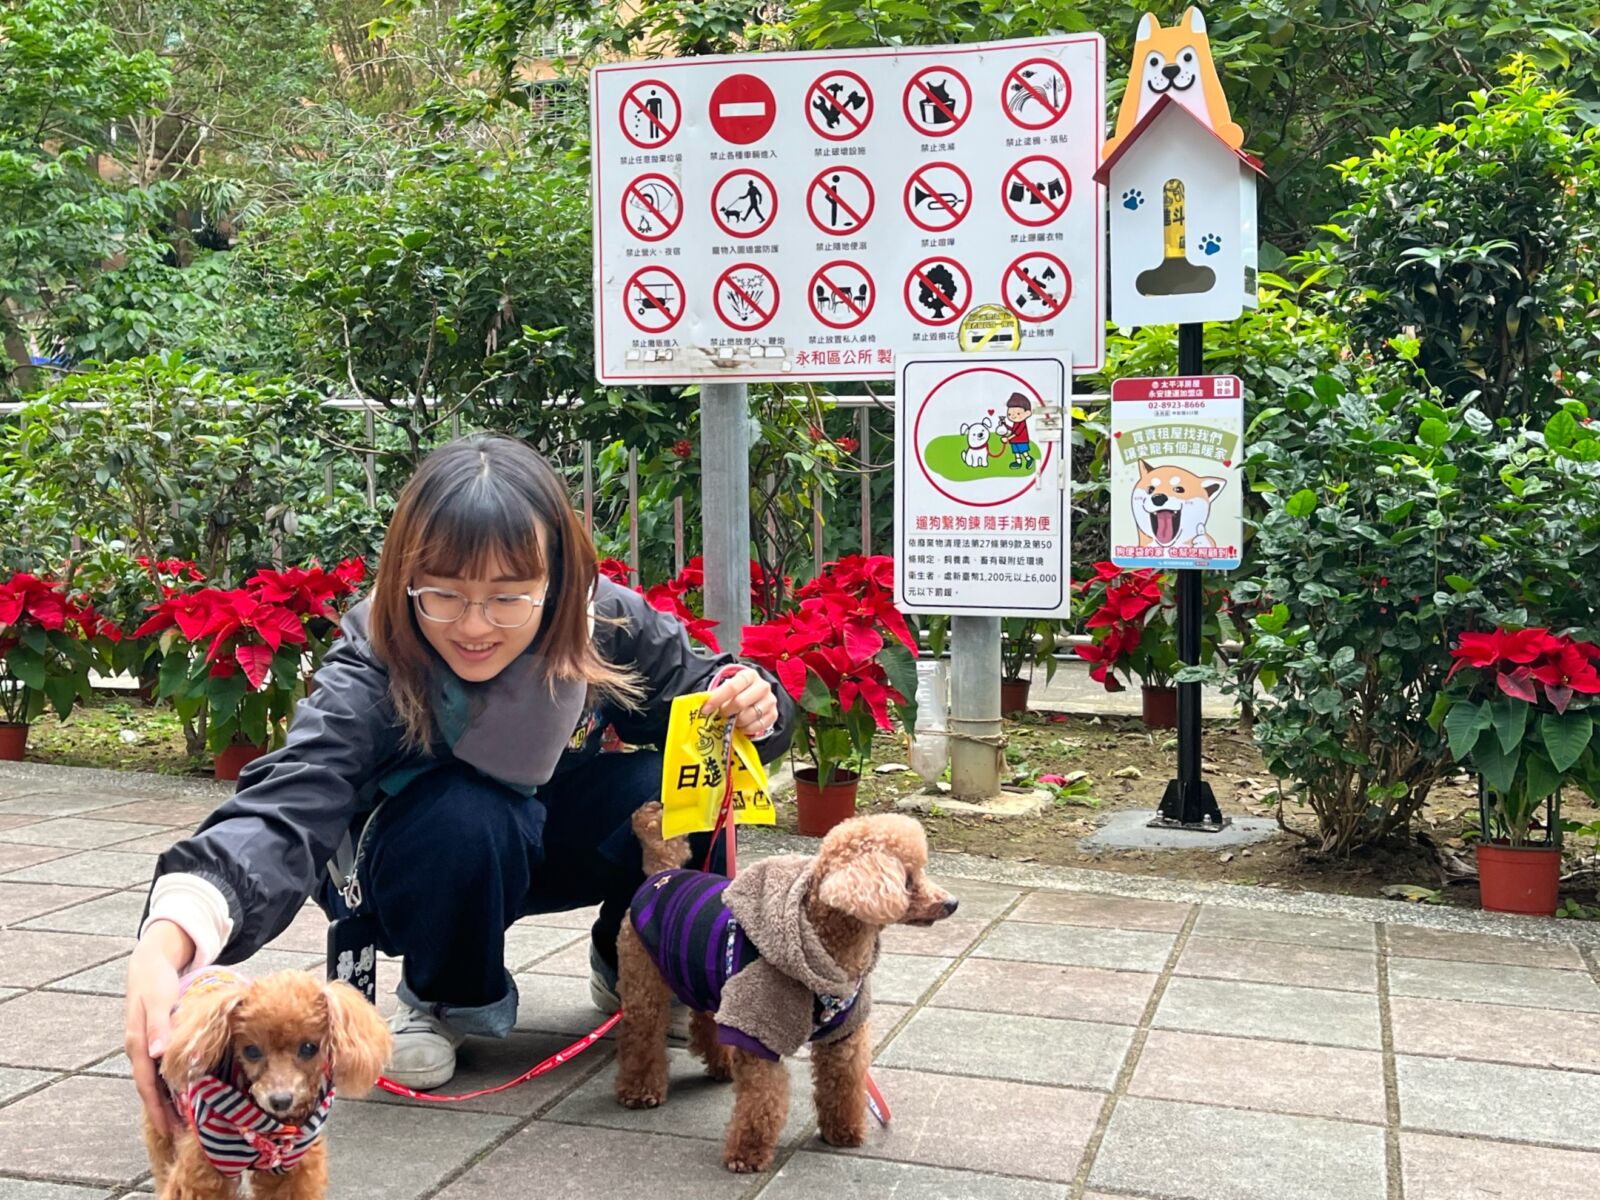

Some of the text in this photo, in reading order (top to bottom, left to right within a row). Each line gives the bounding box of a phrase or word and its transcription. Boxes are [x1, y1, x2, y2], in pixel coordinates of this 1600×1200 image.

[710, 149, 778, 161] 禁止各種車輛進入
[814, 146, 866, 157] 禁止破壞設施
[808, 334, 876, 345] 禁止放置私人桌椅
[912, 331, 960, 341] 禁止毀損花
[796, 349, 893, 366] 永和區公所 製
[1148, 401, 1206, 409] 02-8923-8666
[984, 515, 1051, 531] 隨手清狗便
